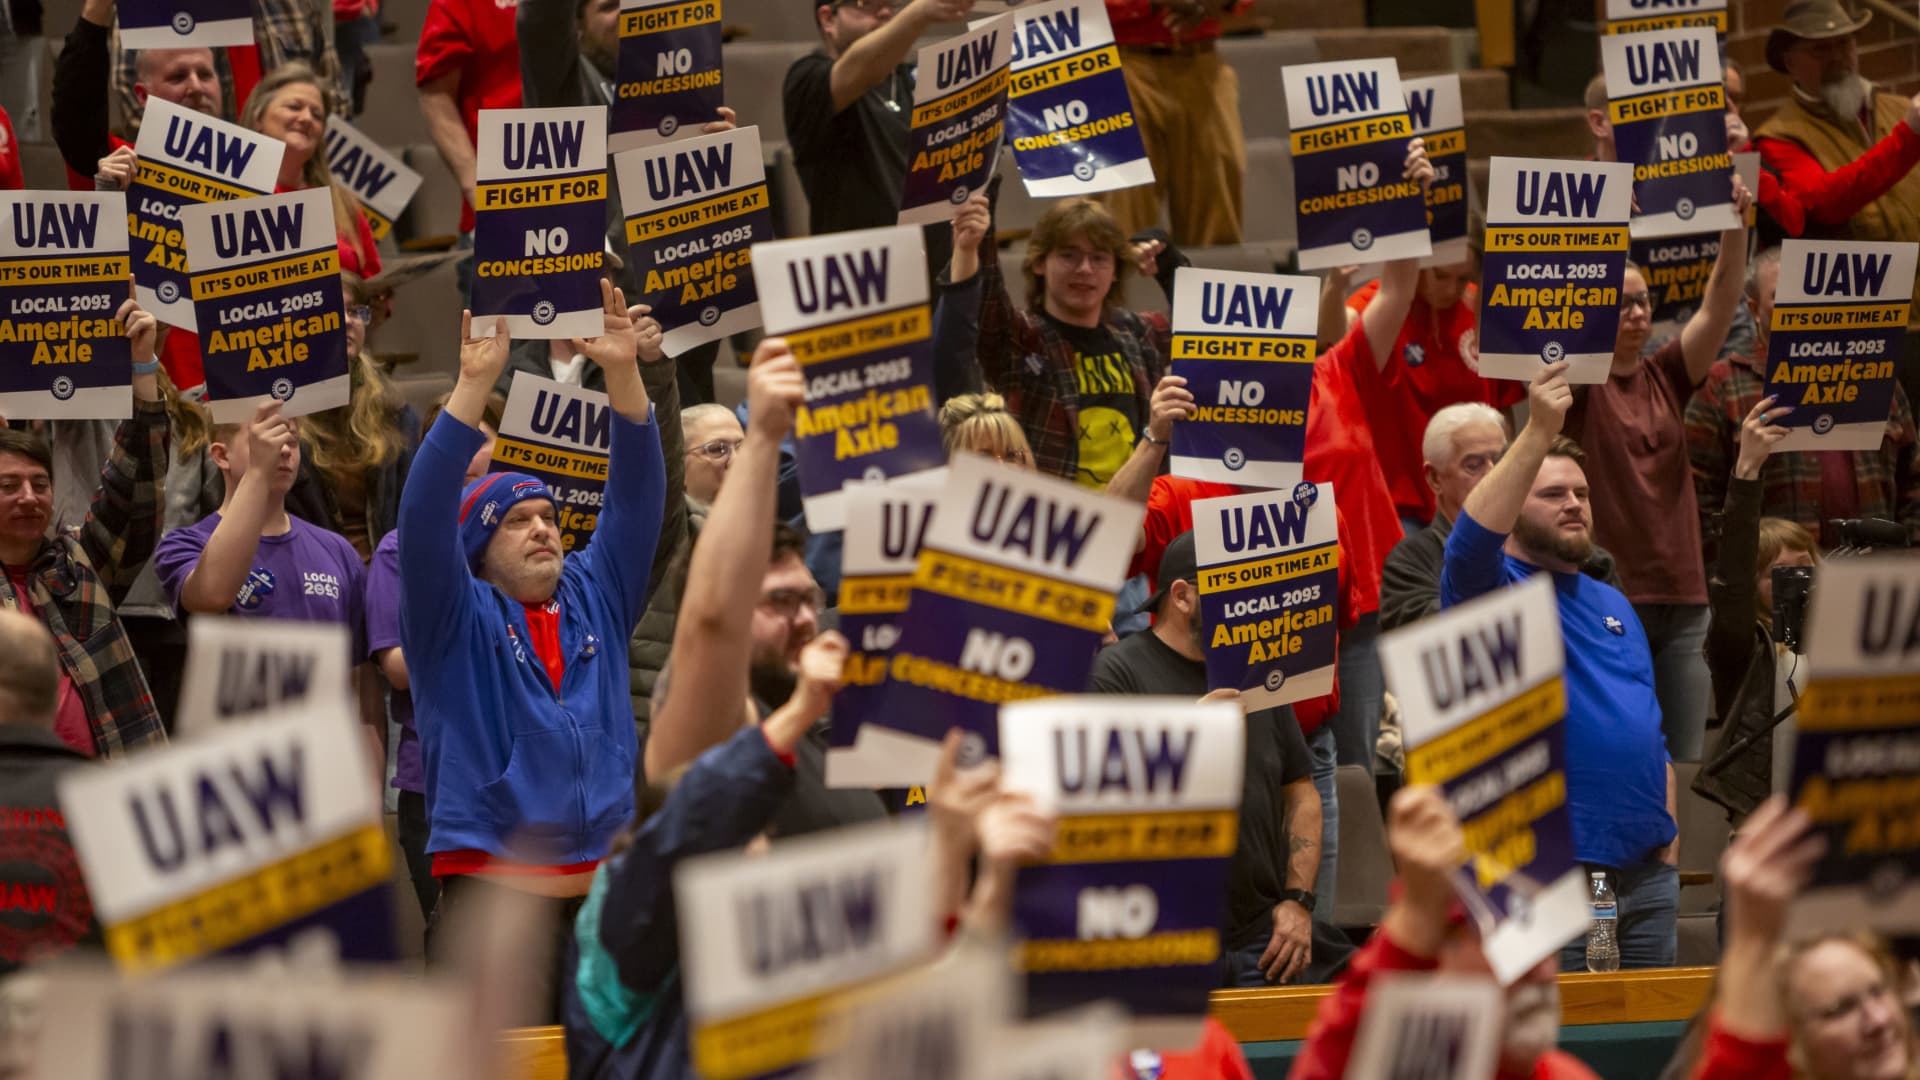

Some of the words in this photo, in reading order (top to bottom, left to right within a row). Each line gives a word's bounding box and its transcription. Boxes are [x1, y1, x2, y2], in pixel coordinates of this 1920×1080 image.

[627, 10, 678, 32] FIGHT
[683, 3, 714, 22] FOR
[656, 48, 692, 77] NO
[937, 30, 998, 89] UAW
[1010, 66, 1061, 94] IGHT
[1066, 54, 1110, 77] FOR
[1625, 39, 1700, 86] UAW
[619, 69, 721, 98] CONCESSIONS
[1306, 71, 1379, 116] UAW
[919, 102, 943, 122] IT'S
[944, 94, 968, 115] OUR
[970, 83, 994, 105] TIME
[1043, 100, 1088, 131] NO
[1619, 95, 1680, 120] FIGHT
[1685, 89, 1719, 108] FOR
[927, 121, 970, 146] LOCAL
[971, 105, 998, 129] 2093
[1014, 112, 1133, 152] CONCESSIONS
[1300, 127, 1362, 150] FIGHT
[1366, 120, 1405, 138] FOR
[164, 115, 257, 179] UAW
[503, 120, 585, 170] UAW
[912, 121, 1004, 172] American
[1659, 132, 1698, 160] NO
[137, 167, 166, 183] IT'S
[169, 176, 201, 194] OUR
[645, 143, 732, 201] UAW
[938, 153, 983, 184] Axle
[1337, 162, 1380, 192] NO
[141, 198, 182, 220] LOC
[486, 184, 555, 206] FIGHT
[560, 179, 599, 199] FOR
[1300, 182, 1420, 215] CONCESSIONS
[1516, 171, 1606, 218] UAW
[12, 202, 99, 248] UAW
[212, 203, 303, 259] UAW
[636, 221, 665, 237] IT'S
[668, 211, 700, 229] OUR
[704, 200, 739, 219] TIME
[741, 193, 759, 209] AT
[524, 227, 568, 256] NO
[655, 240, 710, 264] LOCAL
[712, 225, 752, 246] 2093
[1495, 233, 1525, 245] IT'S
[1528, 233, 1562, 246] OUR
[1565, 232, 1599, 246] TIME
[1601, 232, 1621, 245] AT
[1651, 245, 1698, 262] LOCAL
[1701, 241, 1720, 259] 20
[30, 266, 61, 279] OUR
[64, 264, 99, 277] TIME
[103, 263, 121, 275] AT
[201, 277, 233, 293] IT'S
[237, 272, 268, 289] OUR
[271, 263, 309, 284] TIME
[311, 258, 330, 275] AT
[477, 252, 603, 278] CONCESSIONS
[644, 248, 752, 293] America
[789, 248, 889, 315] UAW
[1507, 264, 1566, 280] LOCAL
[1568, 264, 1607, 279] 2093
[1803, 252, 1891, 297] UAW
[11, 297, 67, 314] LOCAL
[71, 295, 111, 311] 2093
[681, 270, 737, 305] Axle
[1489, 283, 1617, 308] American
[219, 300, 278, 325] LOCAL
[281, 291, 323, 312] 2093
[1201, 282, 1293, 329] UAW
[1522, 307, 1584, 330] Axle
[1780, 311, 1808, 325] IT'S
[1810, 311, 1843, 326] OUR
[1846, 311, 1879, 324] TIME
[1882, 310, 1901, 323] AT
[0, 315, 125, 342] American
[208, 311, 339, 354] American
[32, 340, 91, 365] Axle
[247, 344, 308, 371] Axle
[1183, 340, 1253, 357] FIGHT
[1259, 342, 1306, 358] FOR
[1790, 341, 1844, 357] LOCAL
[1847, 339, 1885, 356] 2093
[1771, 360, 1894, 384] American
[1218, 380, 1265, 406] NO
[1802, 382, 1858, 405] Axle
[796, 384, 930, 439] American
[1187, 406, 1304, 425] ONCESSIONS
[835, 421, 898, 461] Axle
[502, 445, 531, 462] IT'S
[535, 452, 568, 468] OUR
[571, 459, 608, 476] TIME
[970, 480, 1102, 570] UAW
[1220, 501, 1309, 554] UAW
[304, 572, 339, 586] LOCAL
[1207, 570, 1237, 588] IT'S
[1239, 565, 1272, 583] OUR
[1275, 557, 1310, 579] TIME
[1312, 552, 1331, 569] AT
[304, 582, 339, 599] 2093
[1224, 593, 1280, 619] LOCAL
[1282, 584, 1321, 608] 2093
[1211, 603, 1333, 648] American
[960, 627, 1035, 681] NO
[1248, 633, 1303, 667] Axle
[1421, 607, 1525, 715] UAW
[217, 646, 319, 718] UAW
[1052, 725, 1196, 795] UAW
[127, 733, 311, 877] UAW
[1076, 884, 1159, 940] NO
